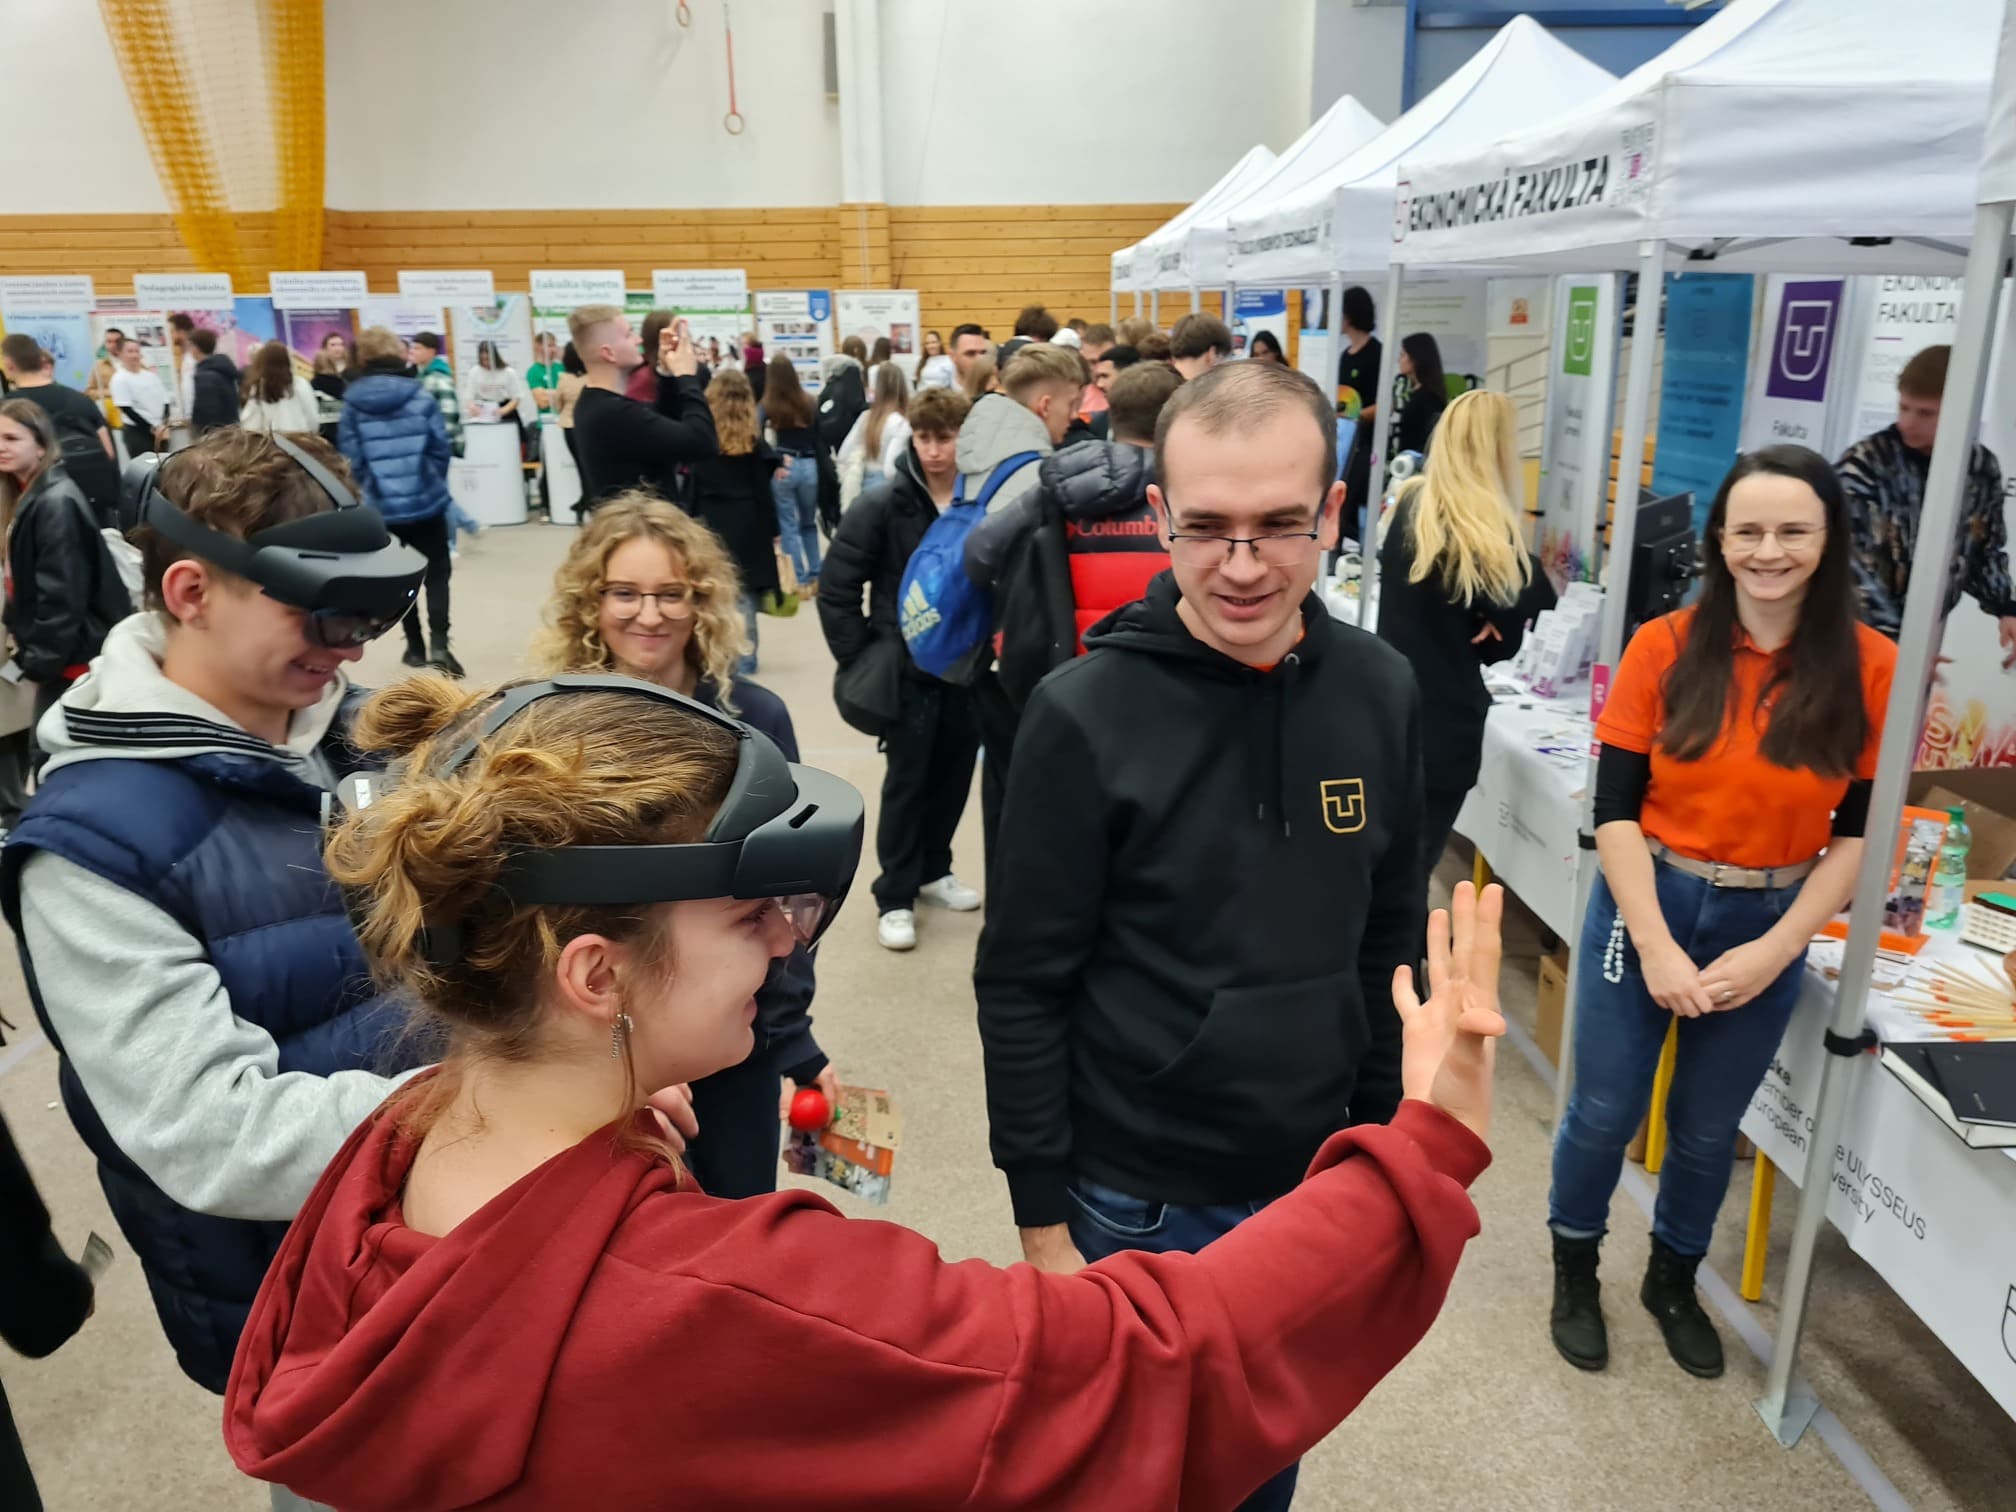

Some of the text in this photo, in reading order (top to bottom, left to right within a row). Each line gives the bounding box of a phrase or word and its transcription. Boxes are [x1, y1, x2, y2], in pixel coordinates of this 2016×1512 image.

[1410, 155, 1609, 231] EKONOMICKÁ FAKULTA
[1877, 302, 1957, 323] FAKULTA
[1847, 1151, 1927, 1241] ULYSSEUS
